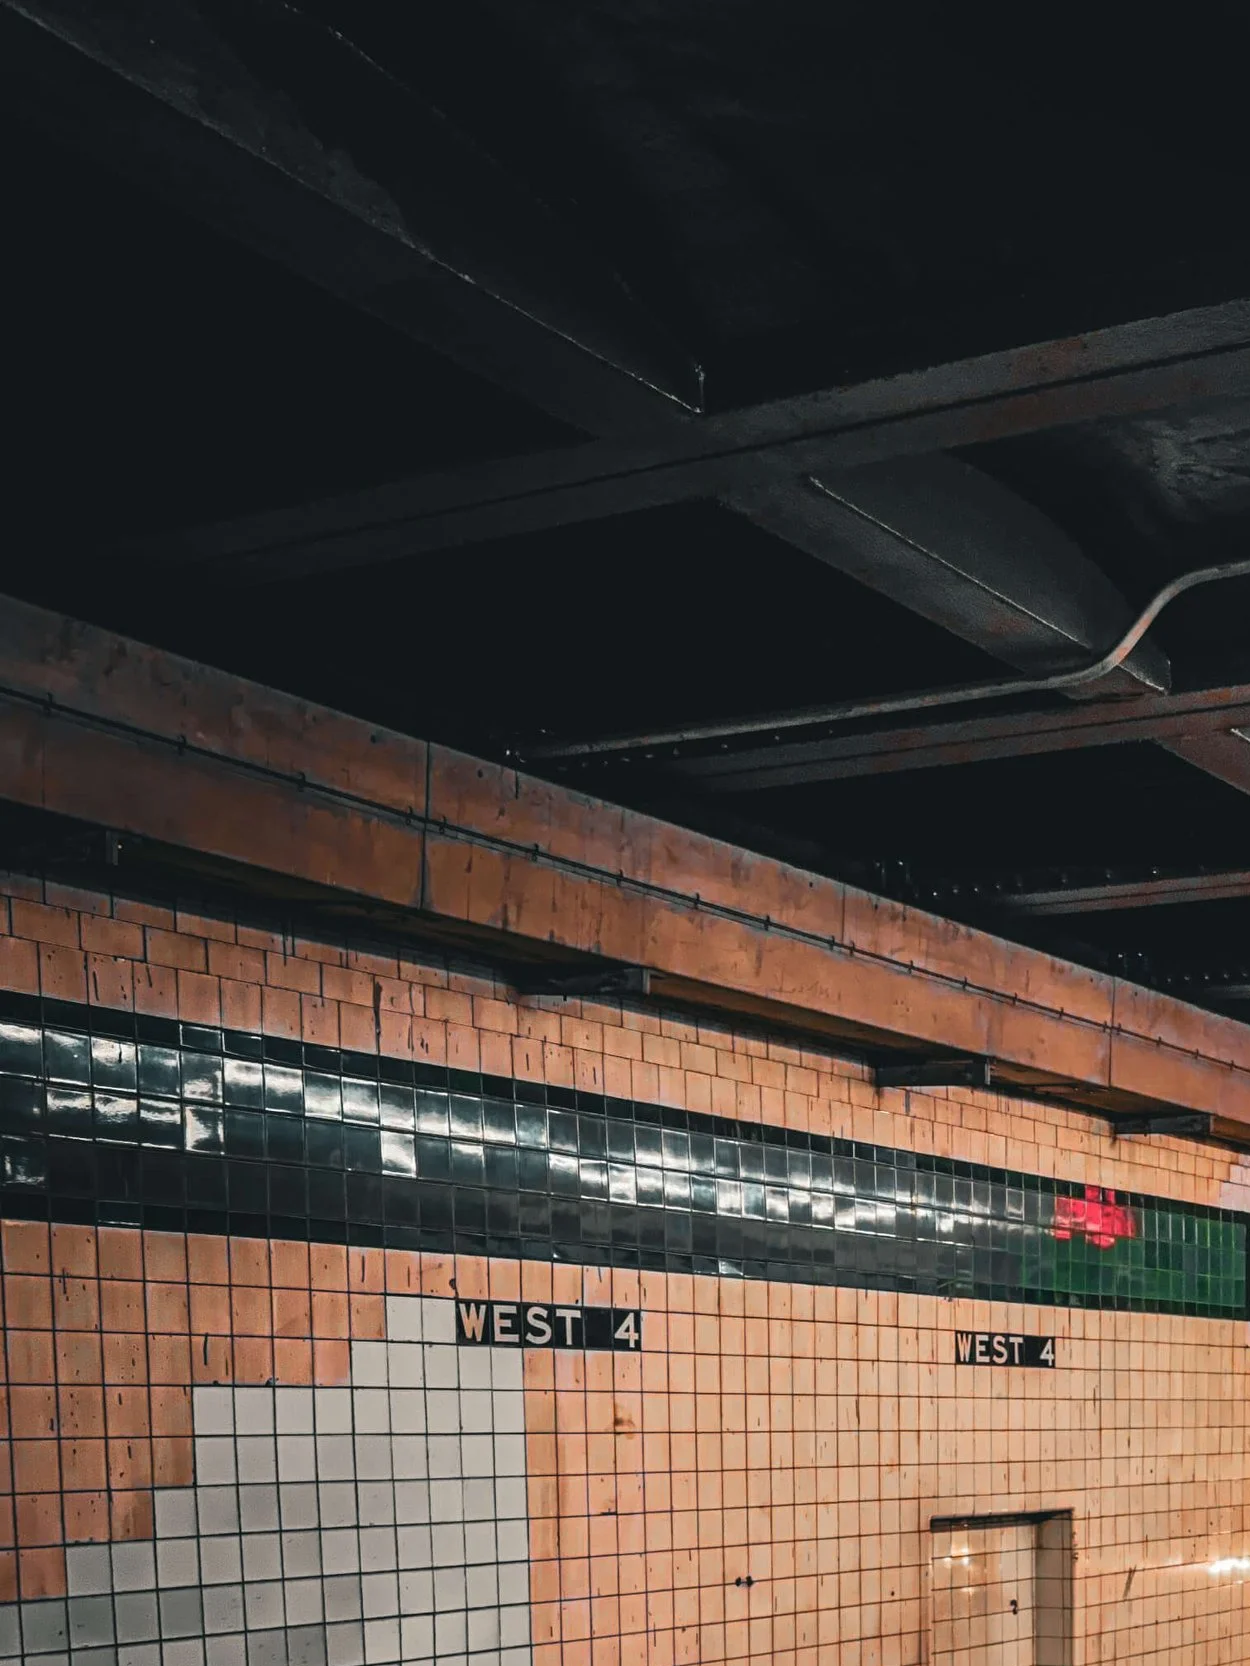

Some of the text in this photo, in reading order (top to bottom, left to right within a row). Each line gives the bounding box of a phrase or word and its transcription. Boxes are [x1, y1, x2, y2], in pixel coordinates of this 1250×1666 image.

[458, 1302, 639, 1348] WEST 4
[956, 1332, 1054, 1366] WEST 4
